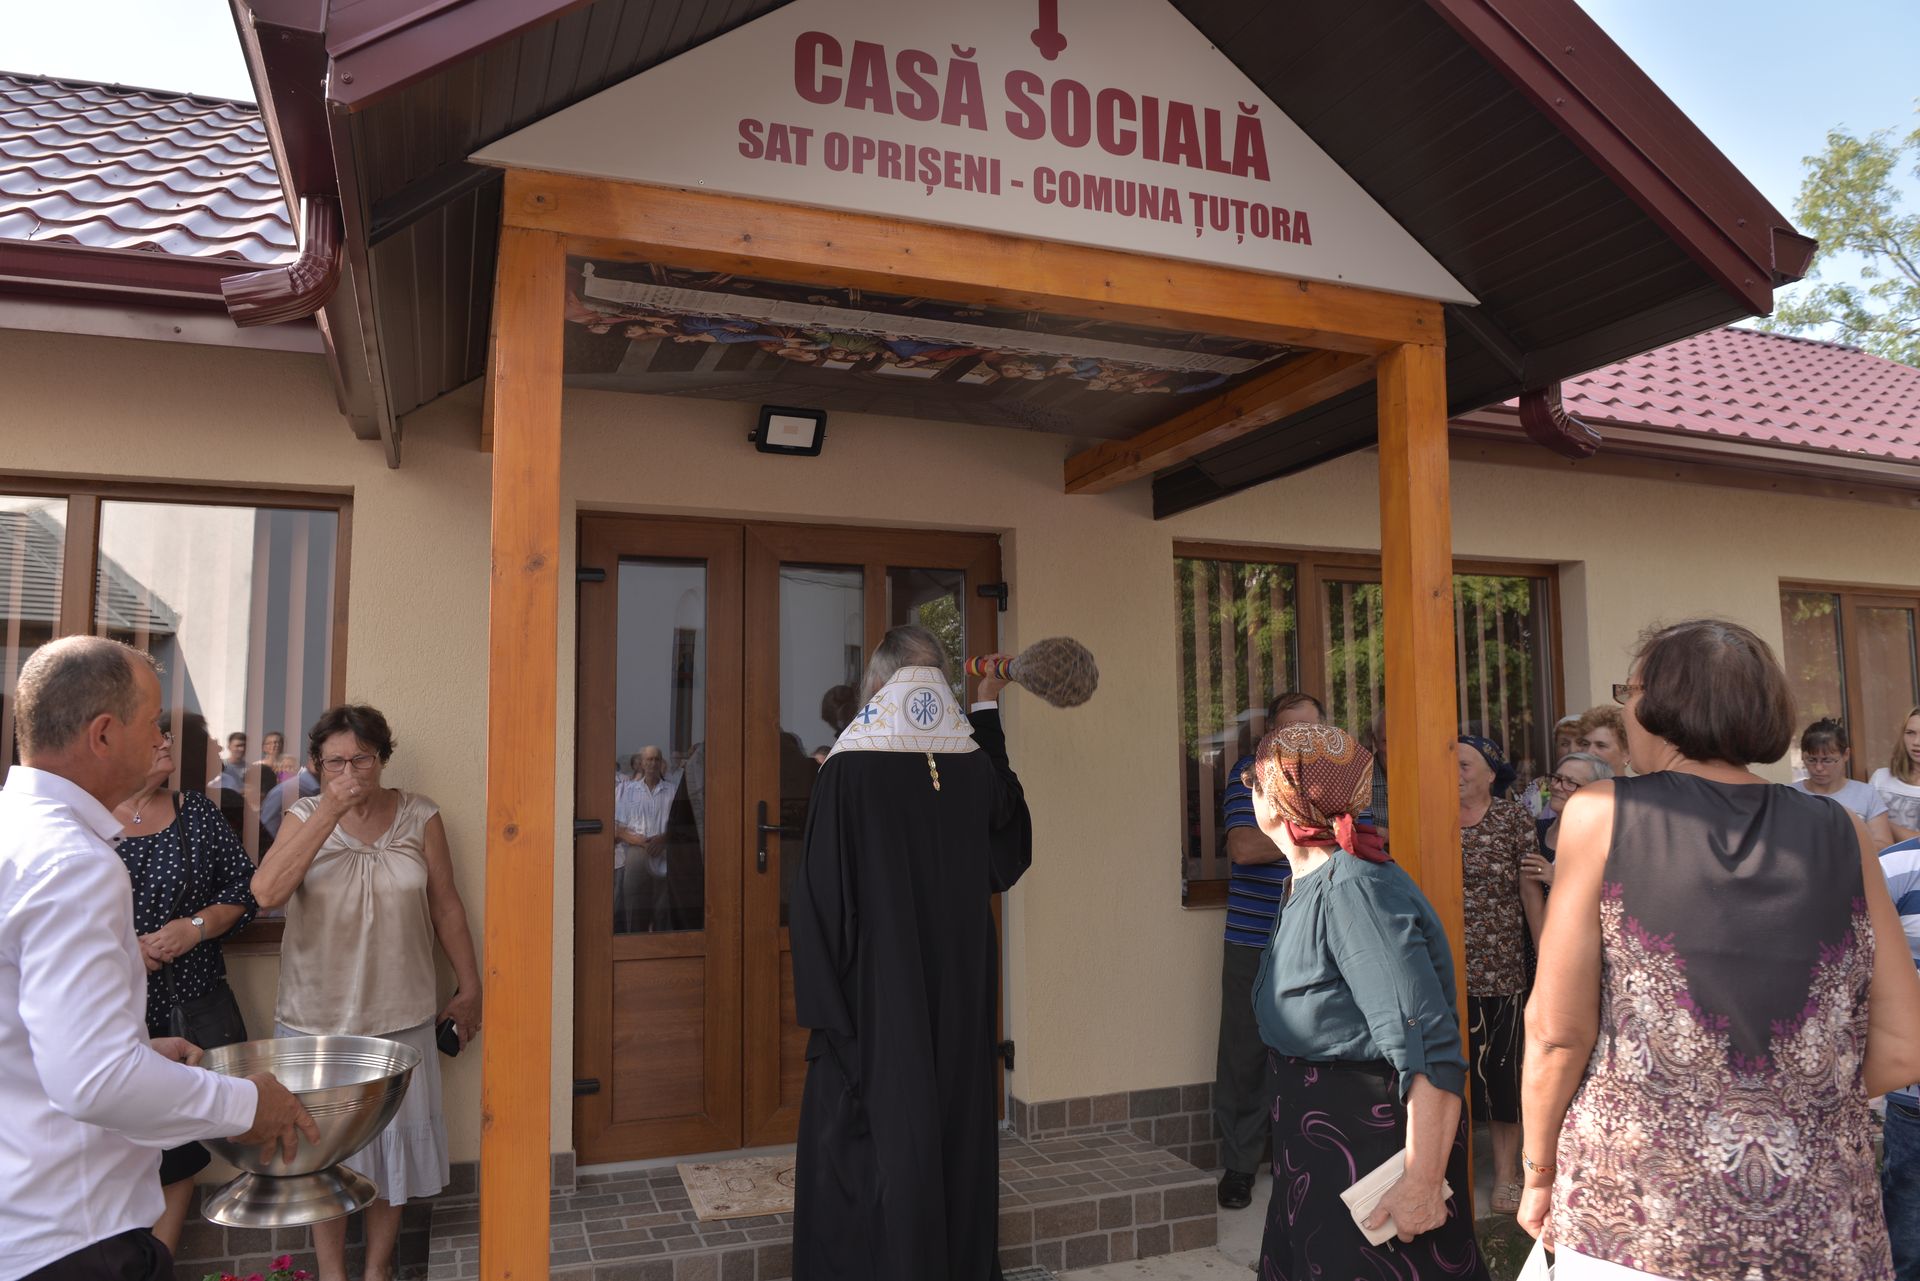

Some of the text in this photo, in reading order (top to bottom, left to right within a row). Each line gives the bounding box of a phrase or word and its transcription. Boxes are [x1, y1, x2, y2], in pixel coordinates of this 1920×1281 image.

[793, 30, 1271, 182] CASĂ SOCIALĂ
[738, 118, 814, 167] SAT
[823, 131, 1001, 197] OPRIȘENI
[1033, 166, 1183, 225] COMUNA
[1188, 191, 1313, 246] ȚUȚORA
